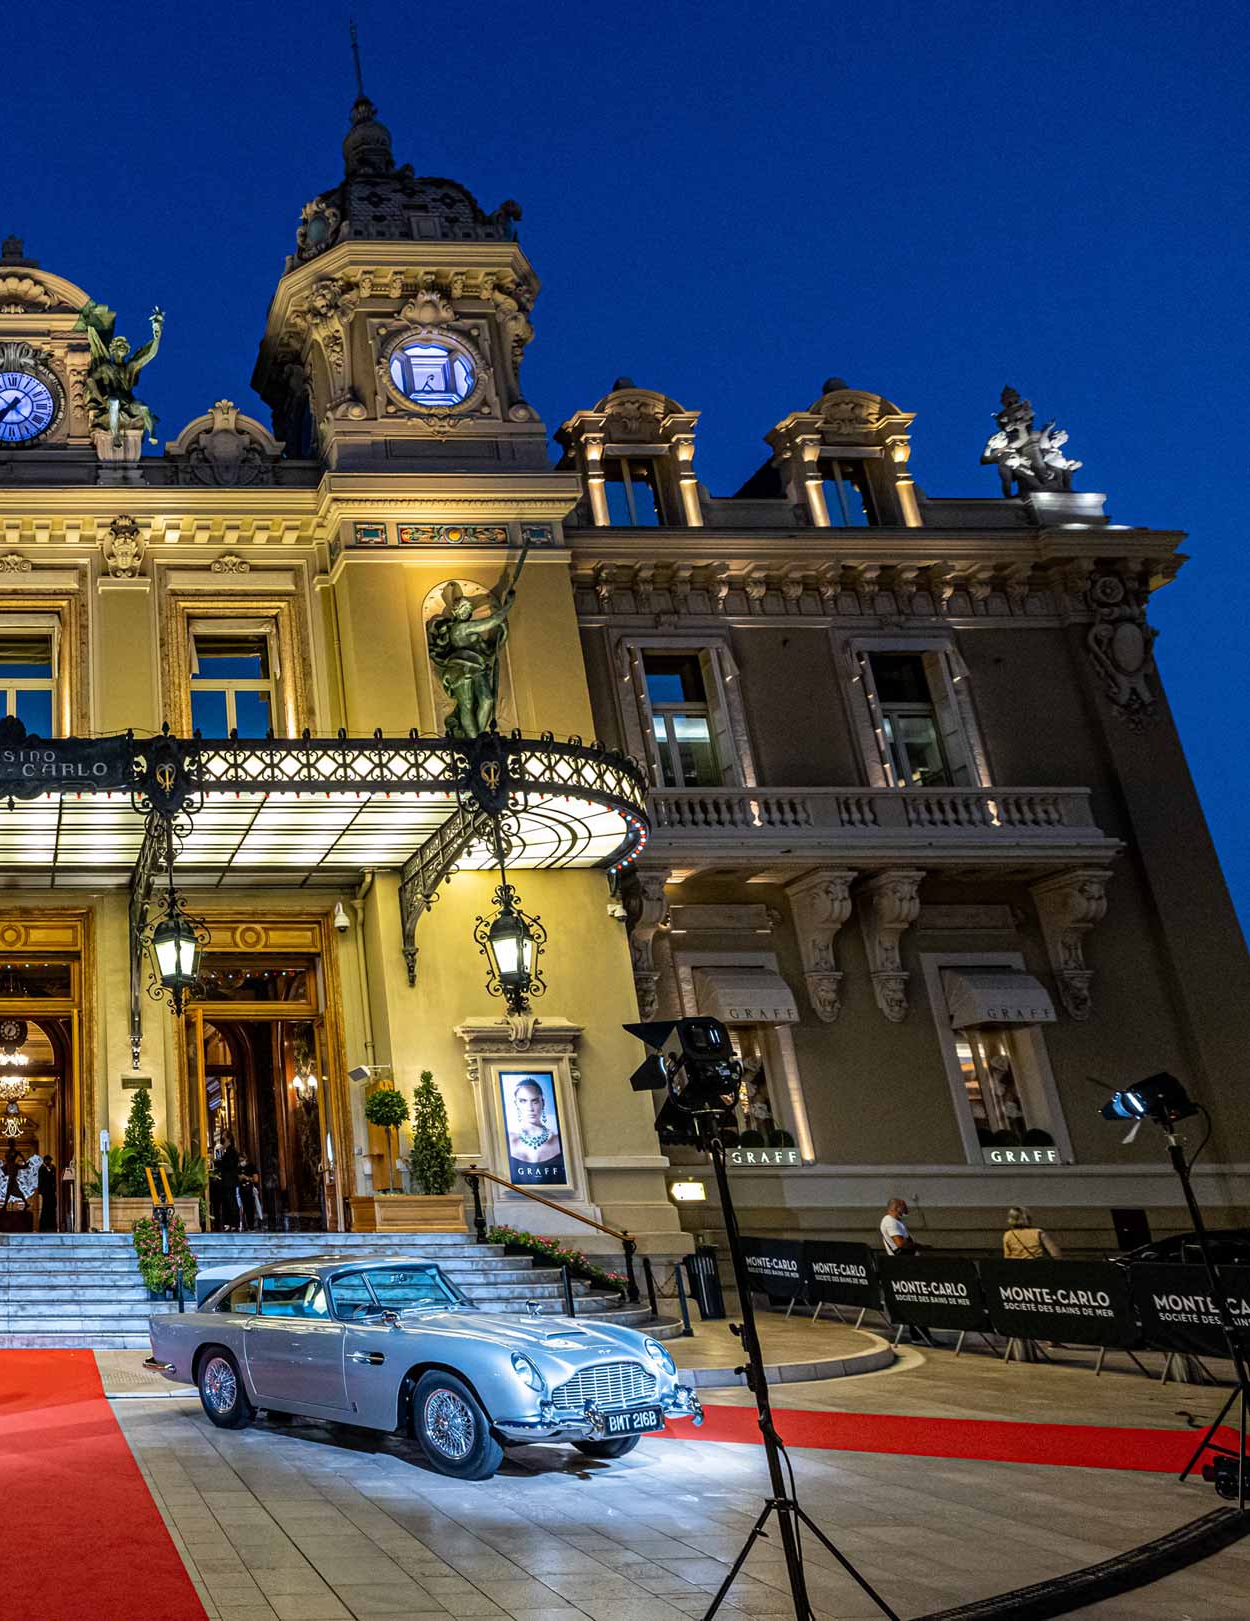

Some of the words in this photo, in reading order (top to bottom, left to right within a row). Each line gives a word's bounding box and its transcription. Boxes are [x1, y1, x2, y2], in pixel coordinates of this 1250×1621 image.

[729, 1008, 795, 1019] GRAFF
[987, 1008, 1052, 1018] GRAFF
[732, 1151, 797, 1163] GRAFF
[991, 1151, 1056, 1162] GRAFF
[517, 1167, 558, 1176] GRAFF
[1038, 1304, 1054, 1313] DES
[1055, 1306, 1081, 1315] BAINS
[1082, 1308, 1094, 1316] DE
[1095, 1309, 1115, 1318] MER
[1201, 1315, 1222, 1325] DES
[609, 1414, 630, 1432] BMT
[632, 1410, 657, 1429] 216B
